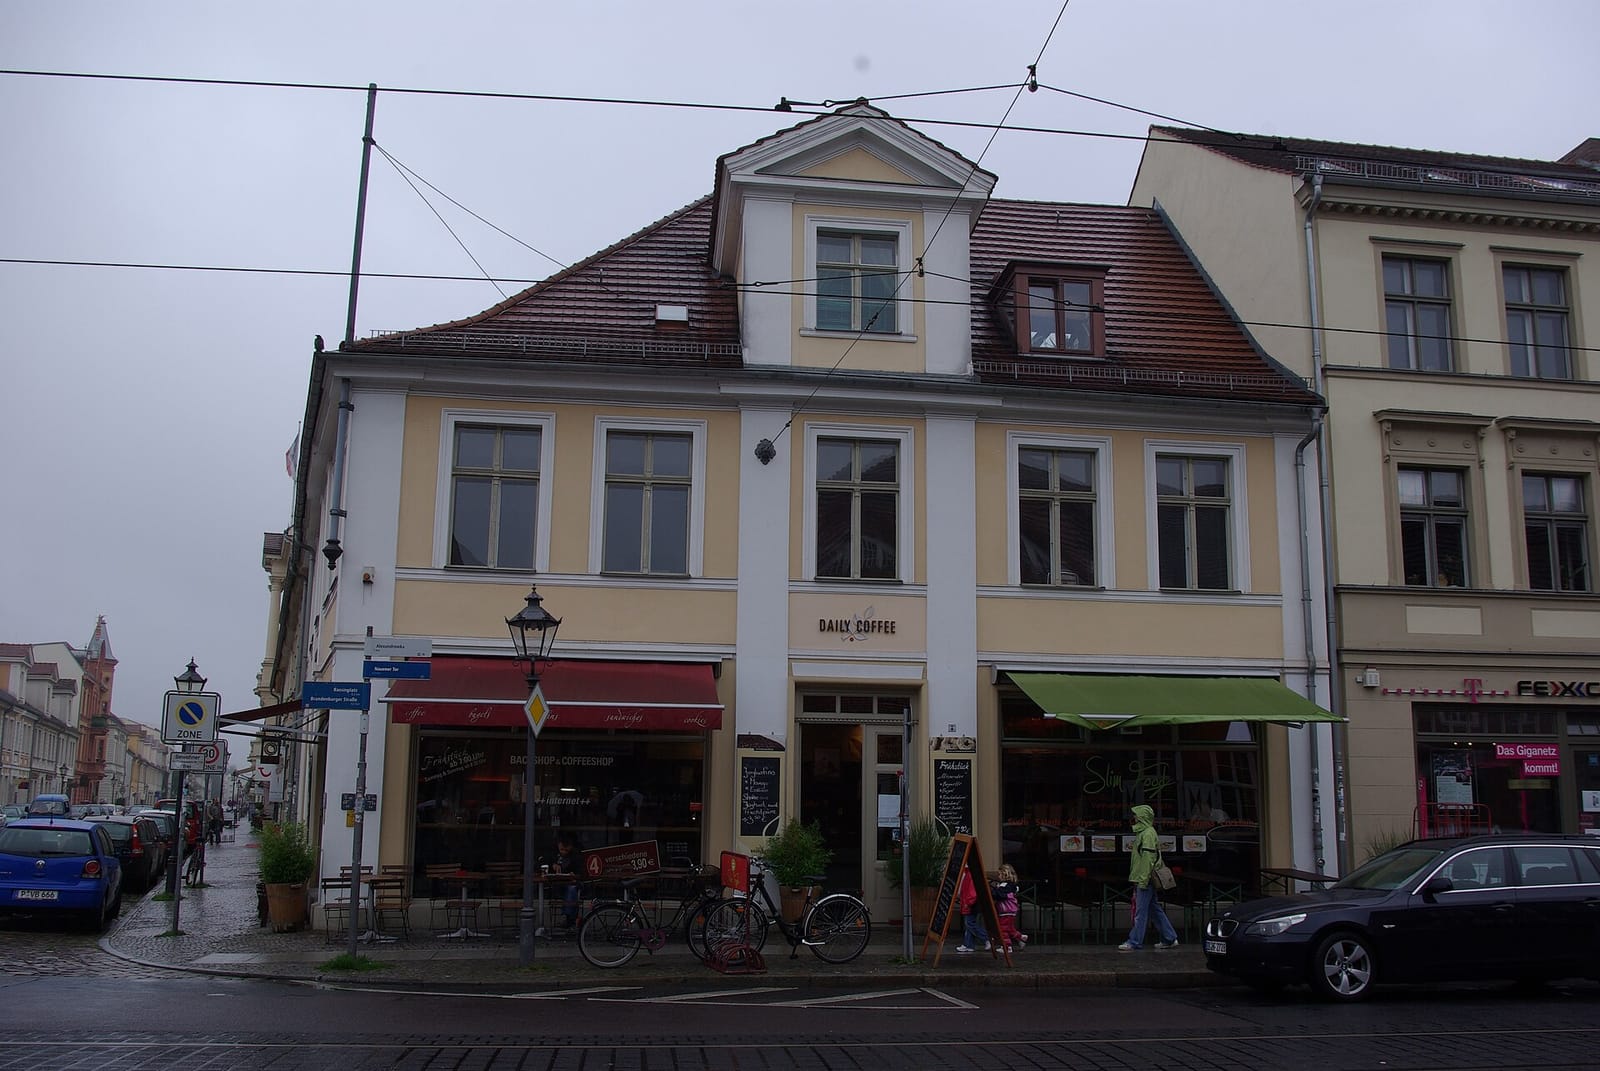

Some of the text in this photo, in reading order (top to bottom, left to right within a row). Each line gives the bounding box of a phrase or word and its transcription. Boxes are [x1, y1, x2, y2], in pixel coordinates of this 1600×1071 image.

[819, 619, 896, 634] DAILY COFFEE
[177, 730, 202, 739] ZONE
[1497, 744, 1557, 758] Das Giganetz
[510, 755, 555, 766] BACSHOP
[561, 755, 614, 767] COFFEESHOP
[1524, 762, 1558, 773] kommt!
[1083, 755, 1124, 794] Slim
[589, 856, 600, 874] 4
